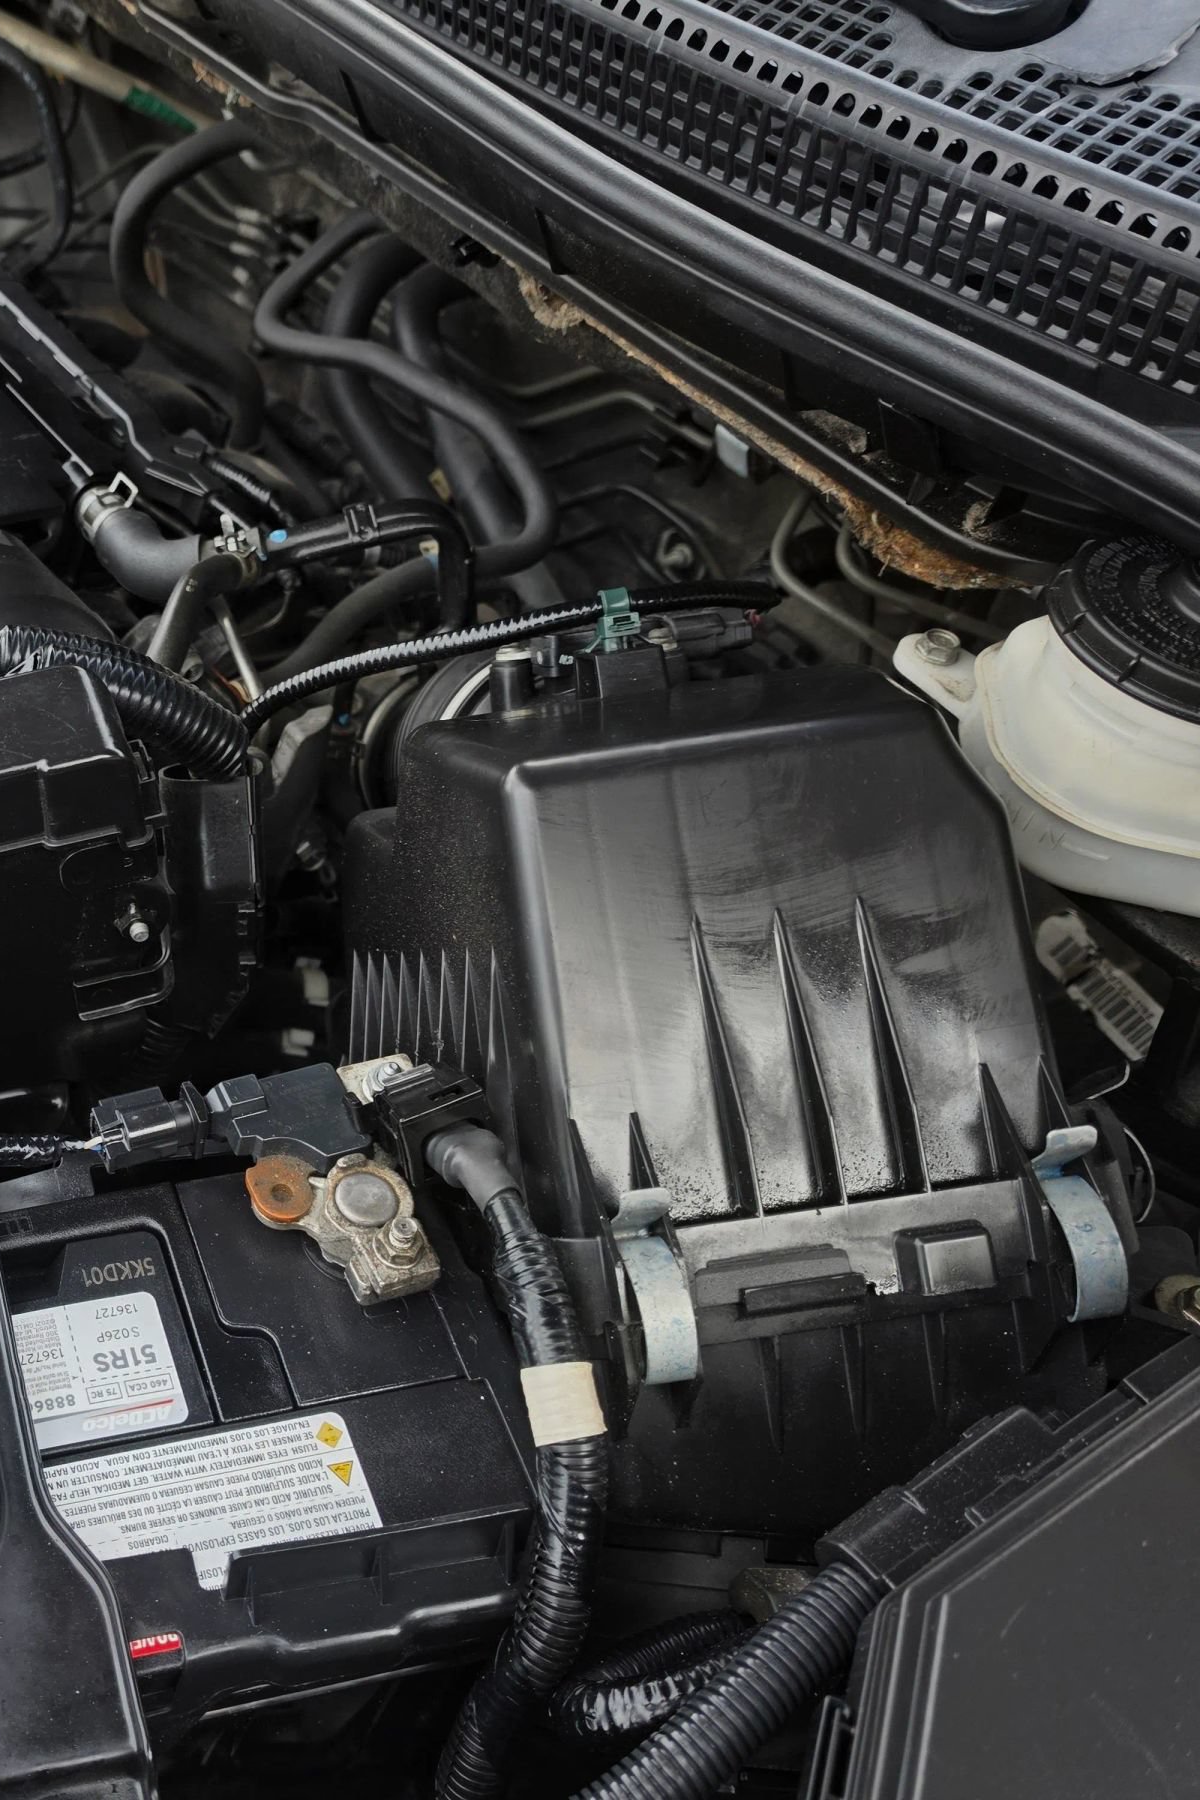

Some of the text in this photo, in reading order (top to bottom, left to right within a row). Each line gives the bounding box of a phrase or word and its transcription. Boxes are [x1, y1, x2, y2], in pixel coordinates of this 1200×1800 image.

[80, 1255, 154, 1285] 5KKD01
[95, 1303, 138, 1319] 136727
[24, 1335, 60, 1347] Distributed
[21, 1347, 64, 1365] 136727
[92, 1344, 157, 1372] 51RS
[128, 1379, 167, 1391] 460 CCA
[91, 1387, 117, 1398] 75 RC
[29, 1394, 75, 1413] 8886
[82, 1405, 171, 1431] ACDelco
[253, 1427, 270, 1438] LOS
[271, 1420, 310, 1434] ENJUAGE
[229, 1431, 252, 1442] OJOS
[270, 1433, 302, 1446] RINSER
[302, 1431, 314, 1440] SE
[152, 1436, 228, 1457] INMEDIATAMENTE
[230, 1443, 253, 1454] YEUX
[254, 1439, 270, 1449] LES
[291, 1442, 318, 1454] FLUSH
[132, 1451, 150, 1461] CON
[197, 1449, 222, 1461] L'EAU
[266, 1448, 288, 1459] EYES
[103, 1454, 129, 1466] AGUA.
[209, 1453, 265, 1471] IMMEDIATELY
[69, 1460, 99, 1473] ACUDA
[184, 1464, 207, 1476] WITH
[70, 1469, 119, 1485] CONSULTER
[133, 1475, 148, 1486] GET
[225, 1473, 250, 1485] PUEDE
[295, 1471, 328, 1485] L'ACIDE
[55, 1479, 68, 1489] UN
[91, 1479, 131, 1494] MEDICAL
[193, 1478, 224, 1491] CAUSAR
[244, 1478, 295, 1496] SULFURIQUE
[69, 1487, 90, 1498] HELP
[151, 1491, 157, 1499] O
[158, 1484, 193, 1497] CEGUERA
[224, 1488, 243, 1499] PEUT
[97, 1493, 150, 1510] QUEMADURAS
[155, 1500, 181, 1512] CÉCITÉ
[182, 1498, 192, 1507] LA
[302, 1501, 333, 1514] CAUSAR
[334, 1495, 365, 1508] PUEDEN
[62, 1503, 96, 1517] FUERTES.
[118, 1484, 333, 1533] SULFURIC ACID CAN CAUSE BLINDNES OR SEVERE BURNS.
[127, 1508, 142, 1518] DES
[143, 1505, 155, 1515] OU
[274, 1508, 302, 1520] DAÑOS
[267, 1513, 273, 1521] O
[313, 1515, 330, 1527] LOS
[330, 1507, 370, 1523] PROTEJA
[267, 1524, 285, 1536] LOS
[285, 1519, 312, 1532] OJOS.
[237, 1528, 266, 1542] GASES
[127, 1534, 168, 1550] CIGARROS
